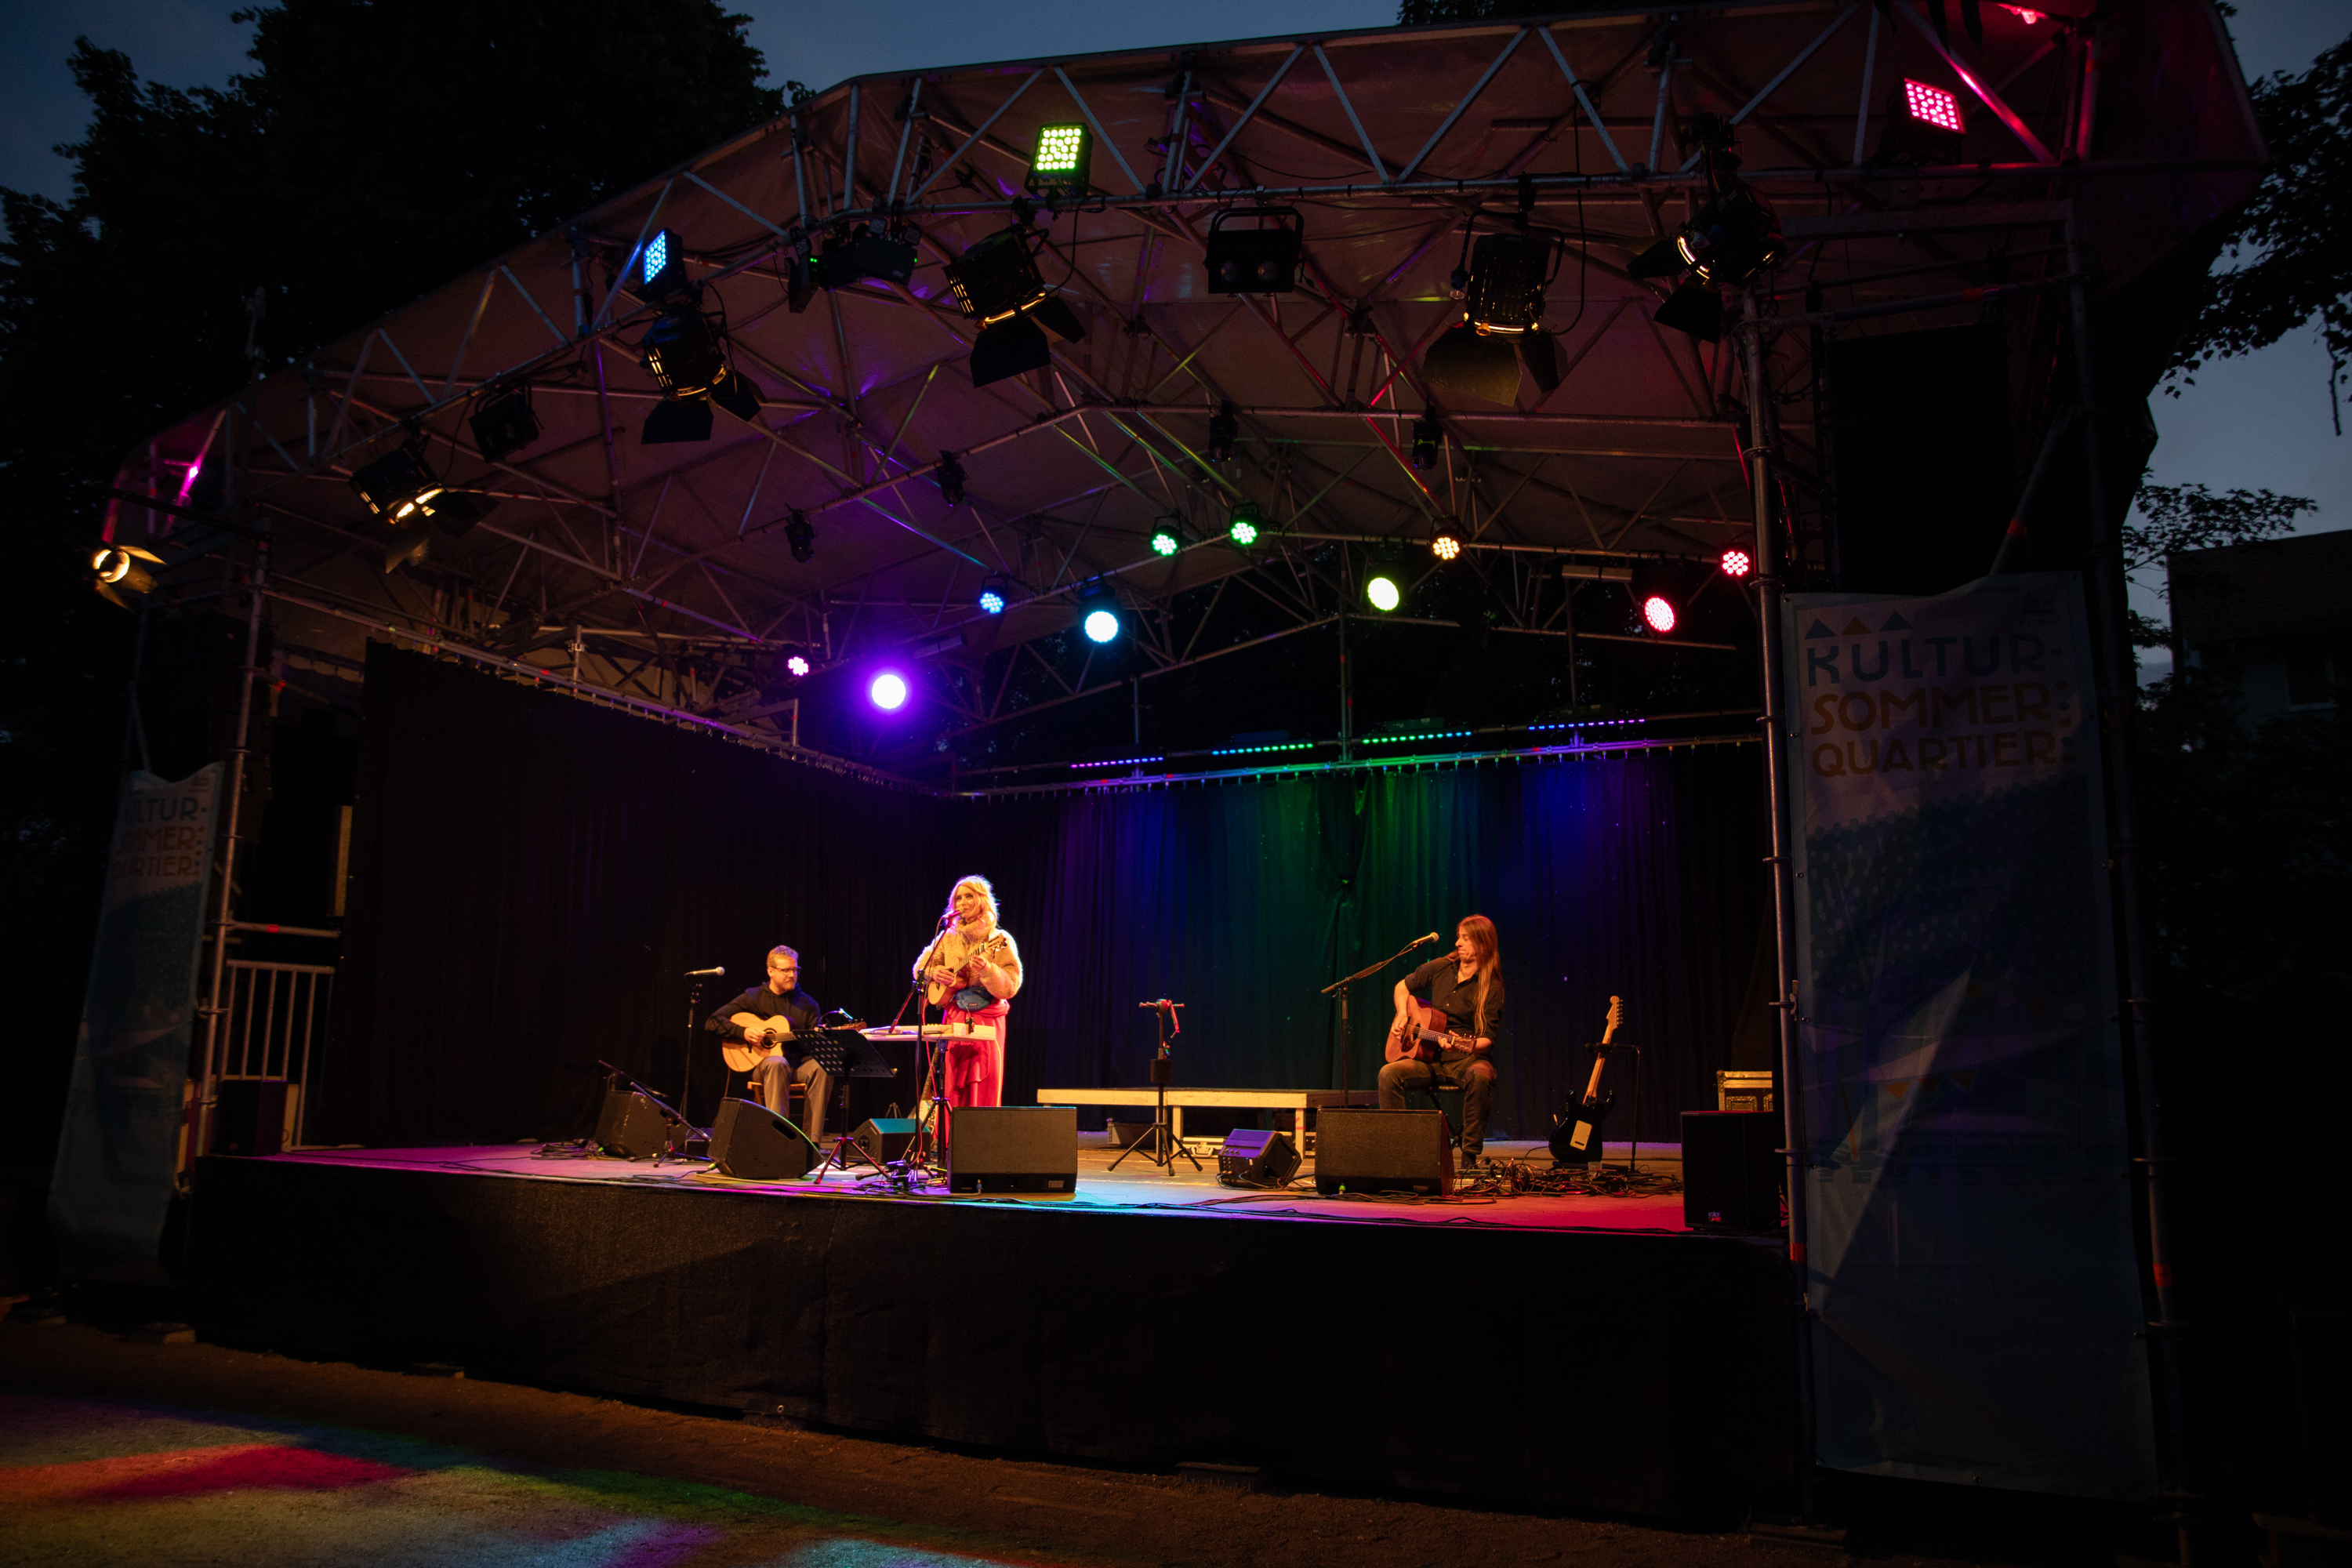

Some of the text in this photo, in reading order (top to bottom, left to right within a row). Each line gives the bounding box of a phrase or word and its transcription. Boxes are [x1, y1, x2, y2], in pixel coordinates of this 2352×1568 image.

[1807, 634, 2045, 686] KULTUR
[1811, 682, 2051, 735] SOMMER
[1811, 731, 2056, 777] QUARTIER
